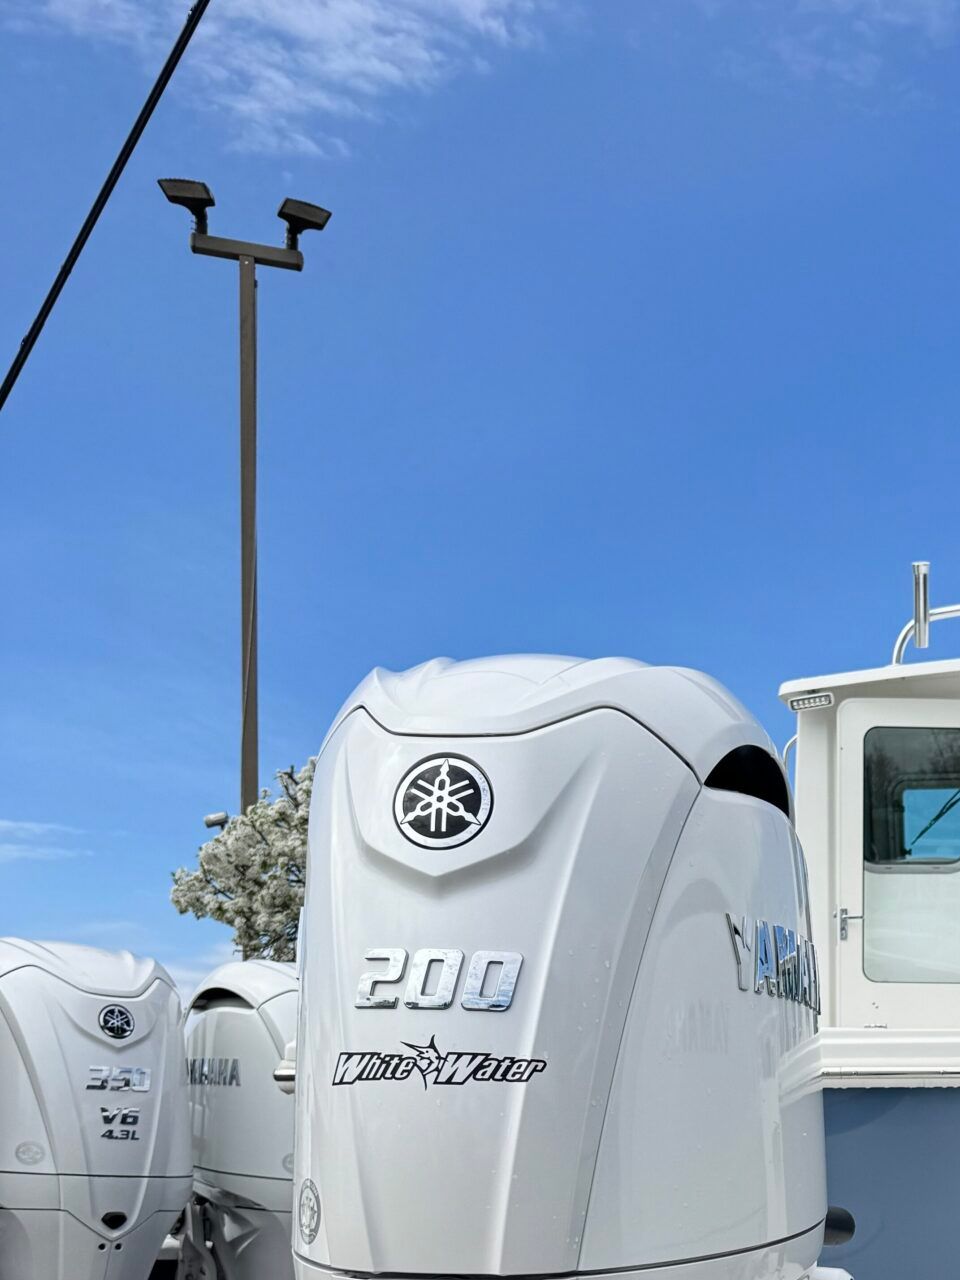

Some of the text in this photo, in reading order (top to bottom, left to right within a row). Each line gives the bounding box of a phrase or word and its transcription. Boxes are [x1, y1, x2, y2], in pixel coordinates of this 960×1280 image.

[354, 947, 525, 1012] 200
[86, 1066, 152, 1092] 350
[332, 1051, 547, 1086] White Water
[100, 1106, 140, 1125] V6
[101, 1129, 140, 1141] 4.3L
